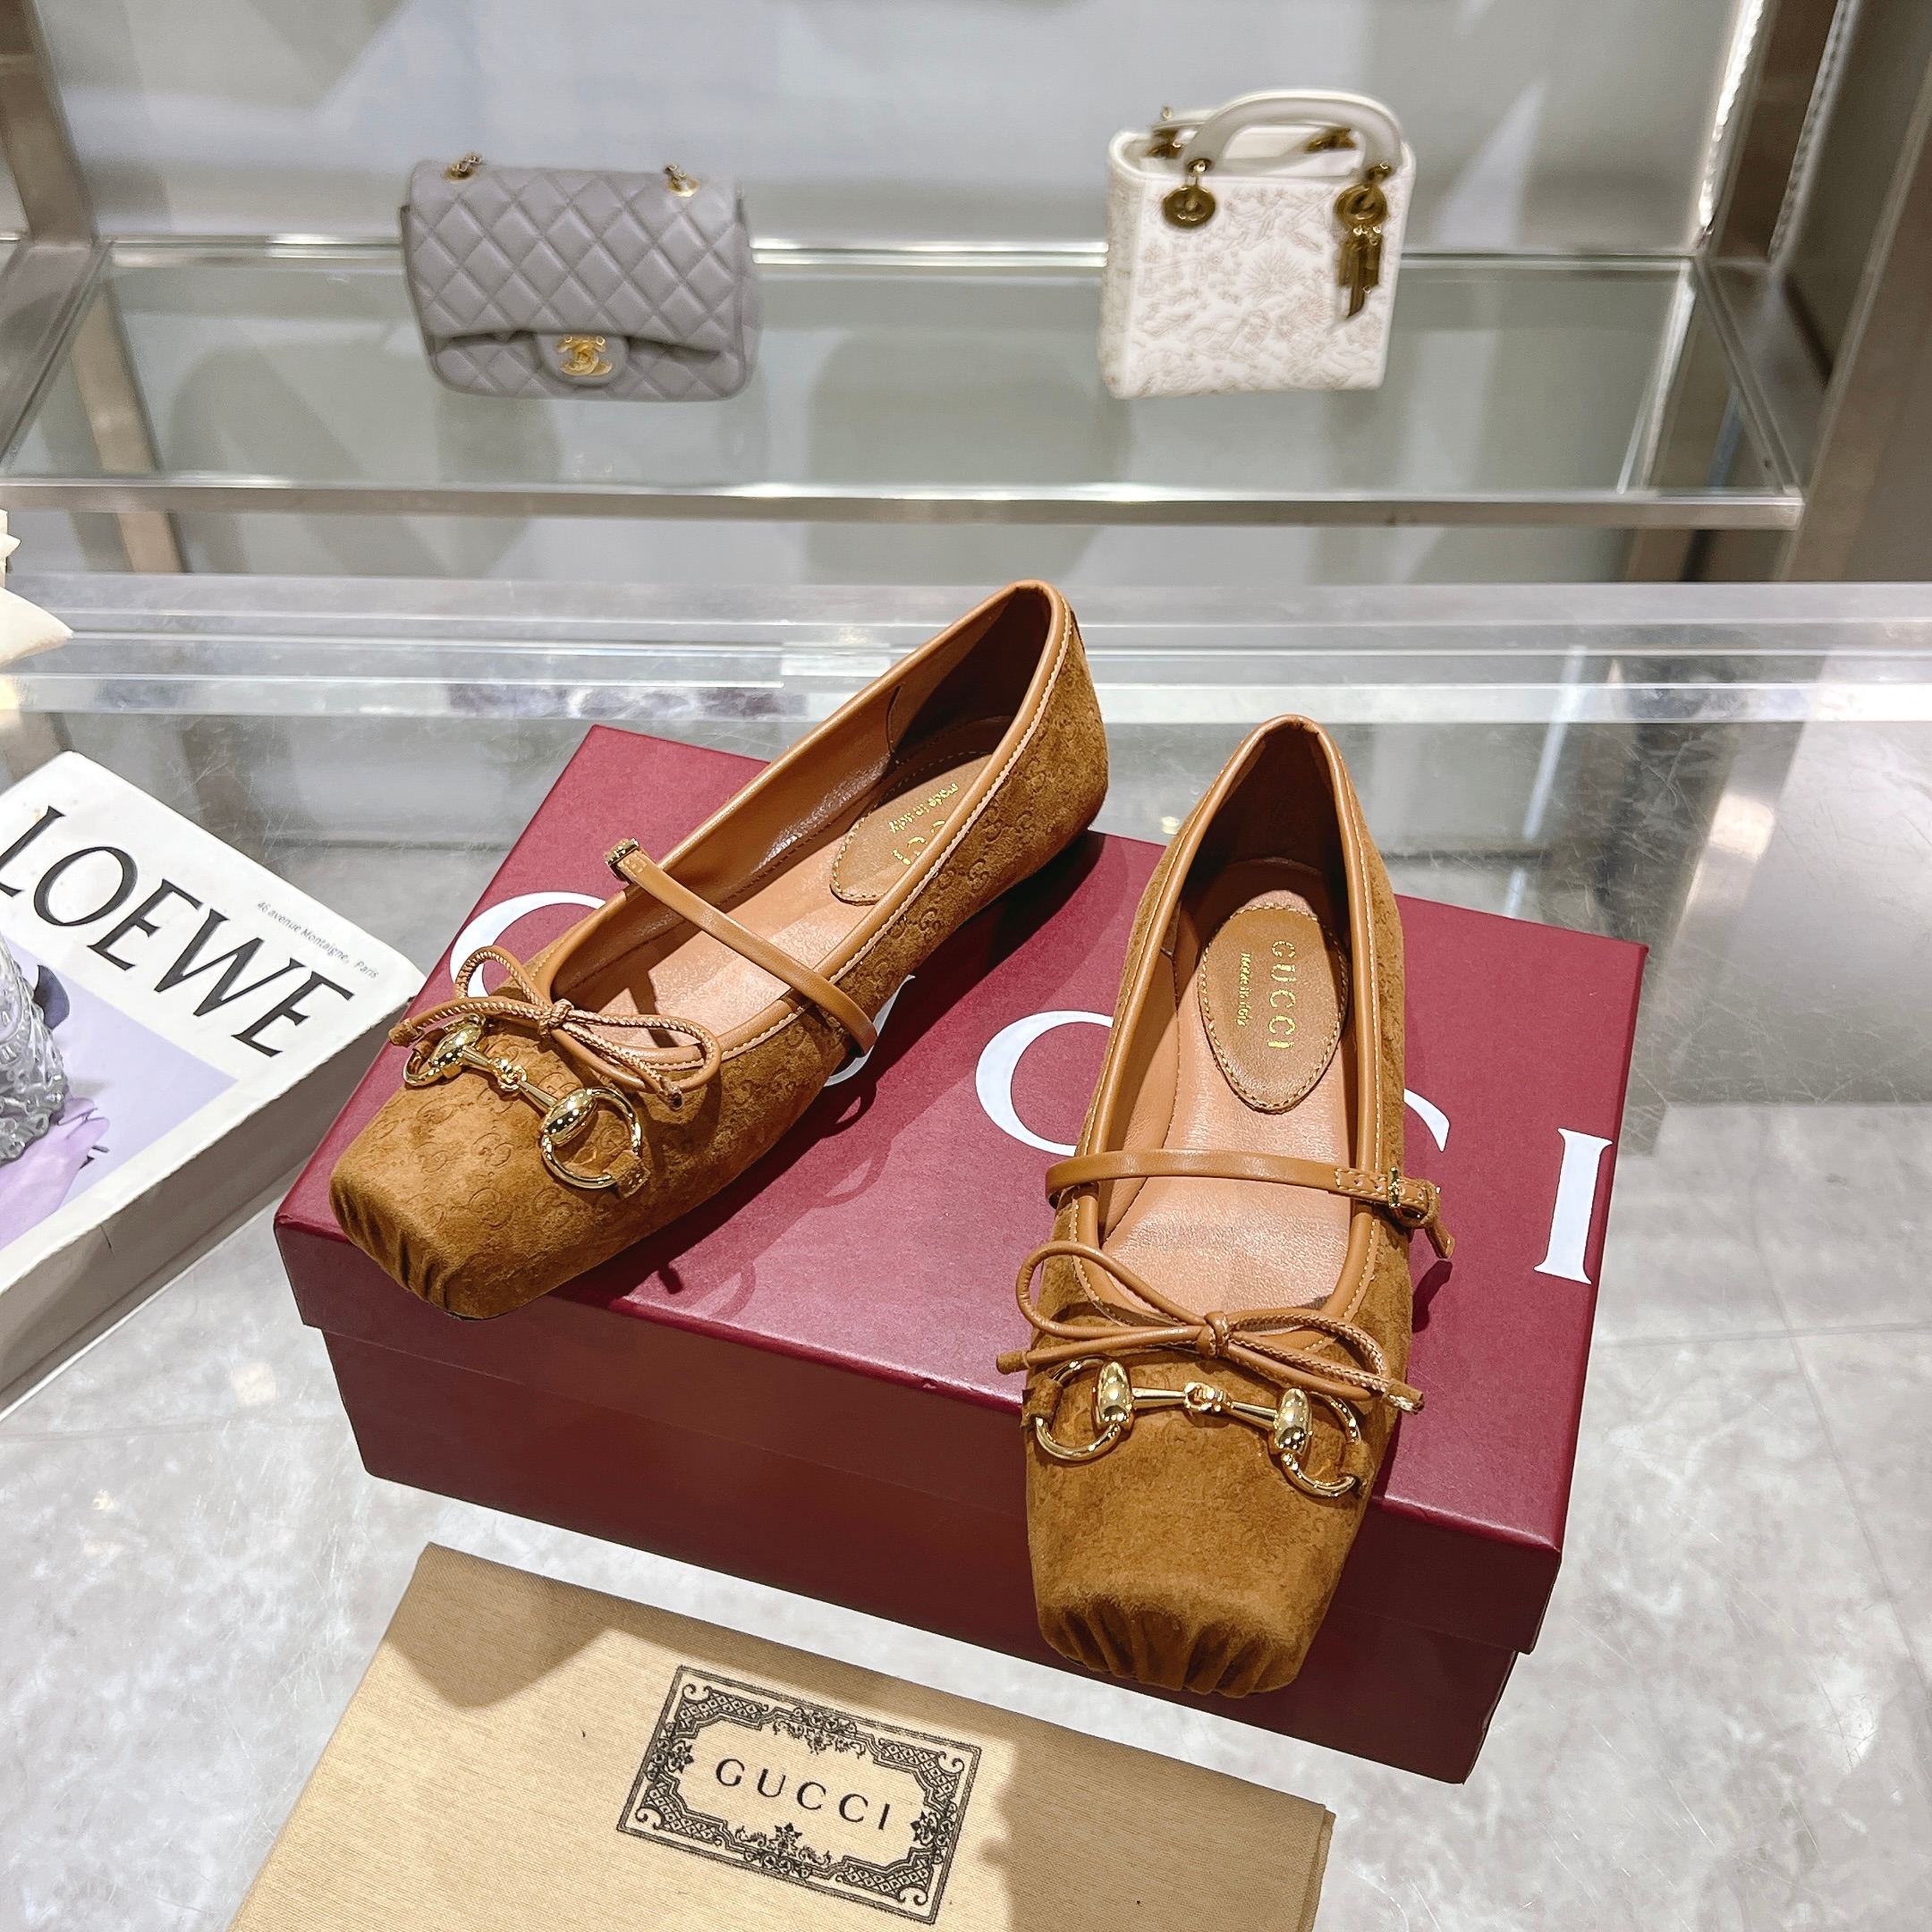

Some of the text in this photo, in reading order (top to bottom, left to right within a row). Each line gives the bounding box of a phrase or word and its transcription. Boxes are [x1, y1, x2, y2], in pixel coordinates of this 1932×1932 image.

[0, 806, 355, 1057] LOEWE
[267, 910, 302, 932] avenue
[354, 960, 379, 979] Paris
[1267, 940, 1296, 1049] GUCCI
[716, 1758, 891, 1830] GUCCI
